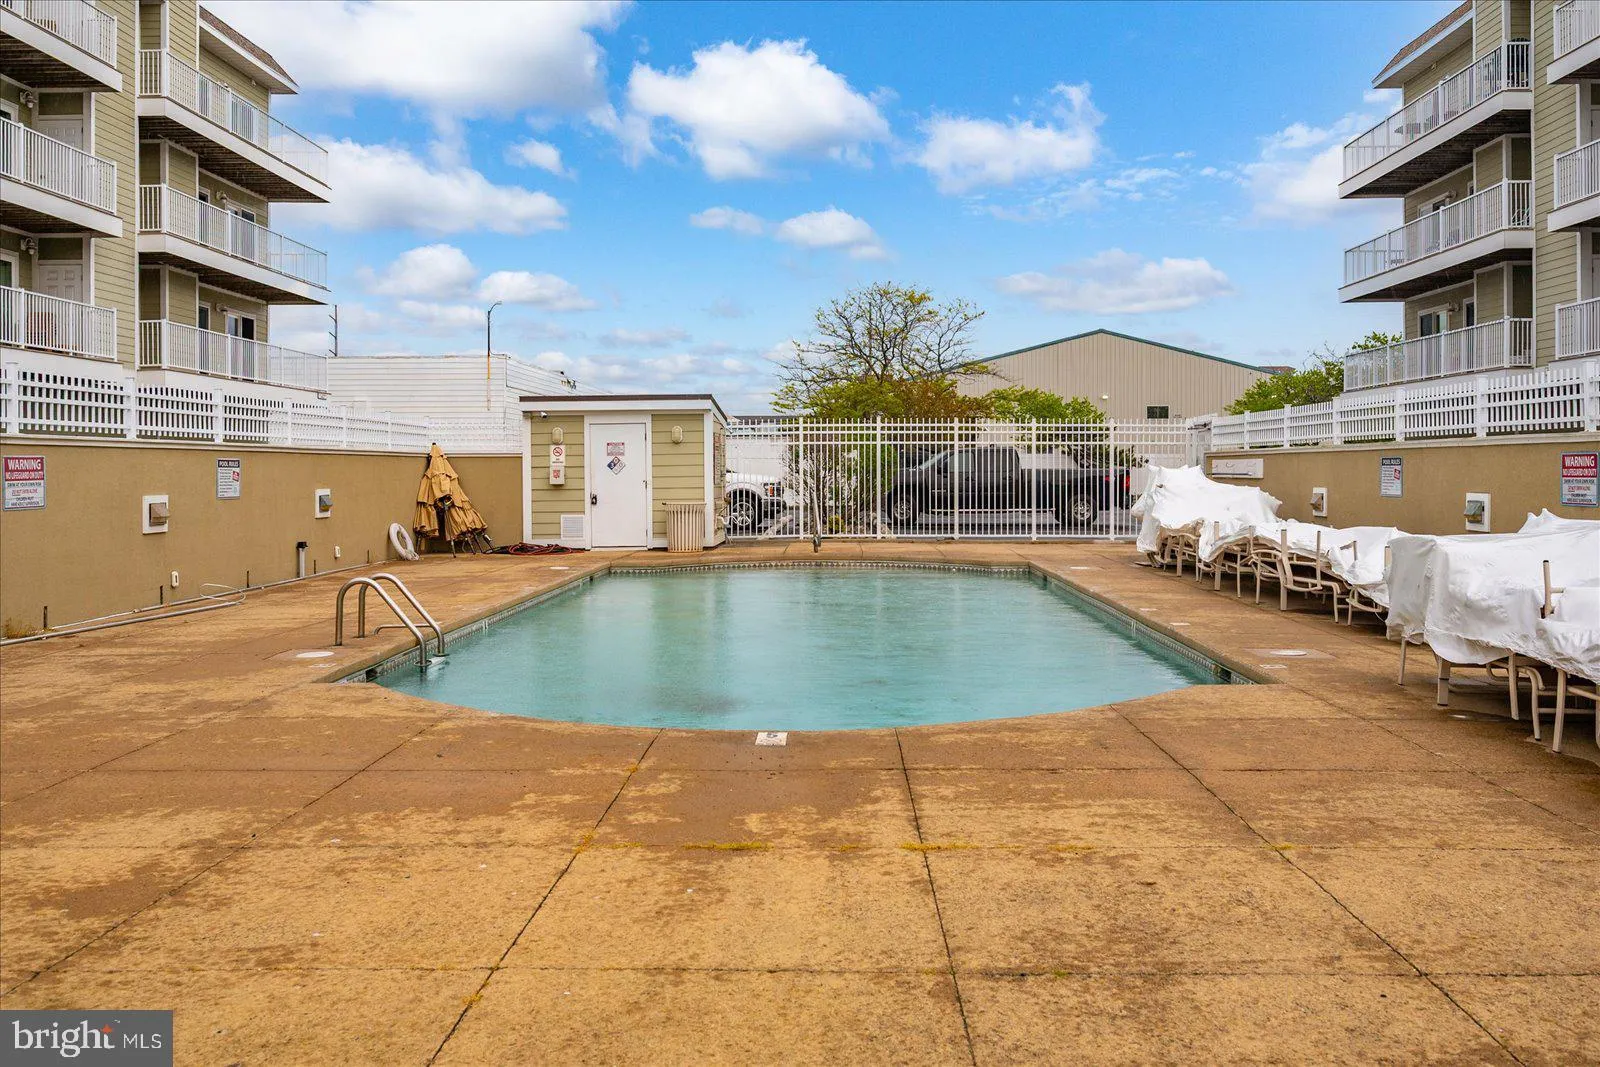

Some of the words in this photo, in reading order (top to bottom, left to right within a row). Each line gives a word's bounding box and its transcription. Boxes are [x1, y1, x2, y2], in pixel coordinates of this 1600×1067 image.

[8, 459, 42, 470] WARNING
[1564, 456, 1594, 466] WARNING
[11, 471, 28, 479] LIFEGUARD
